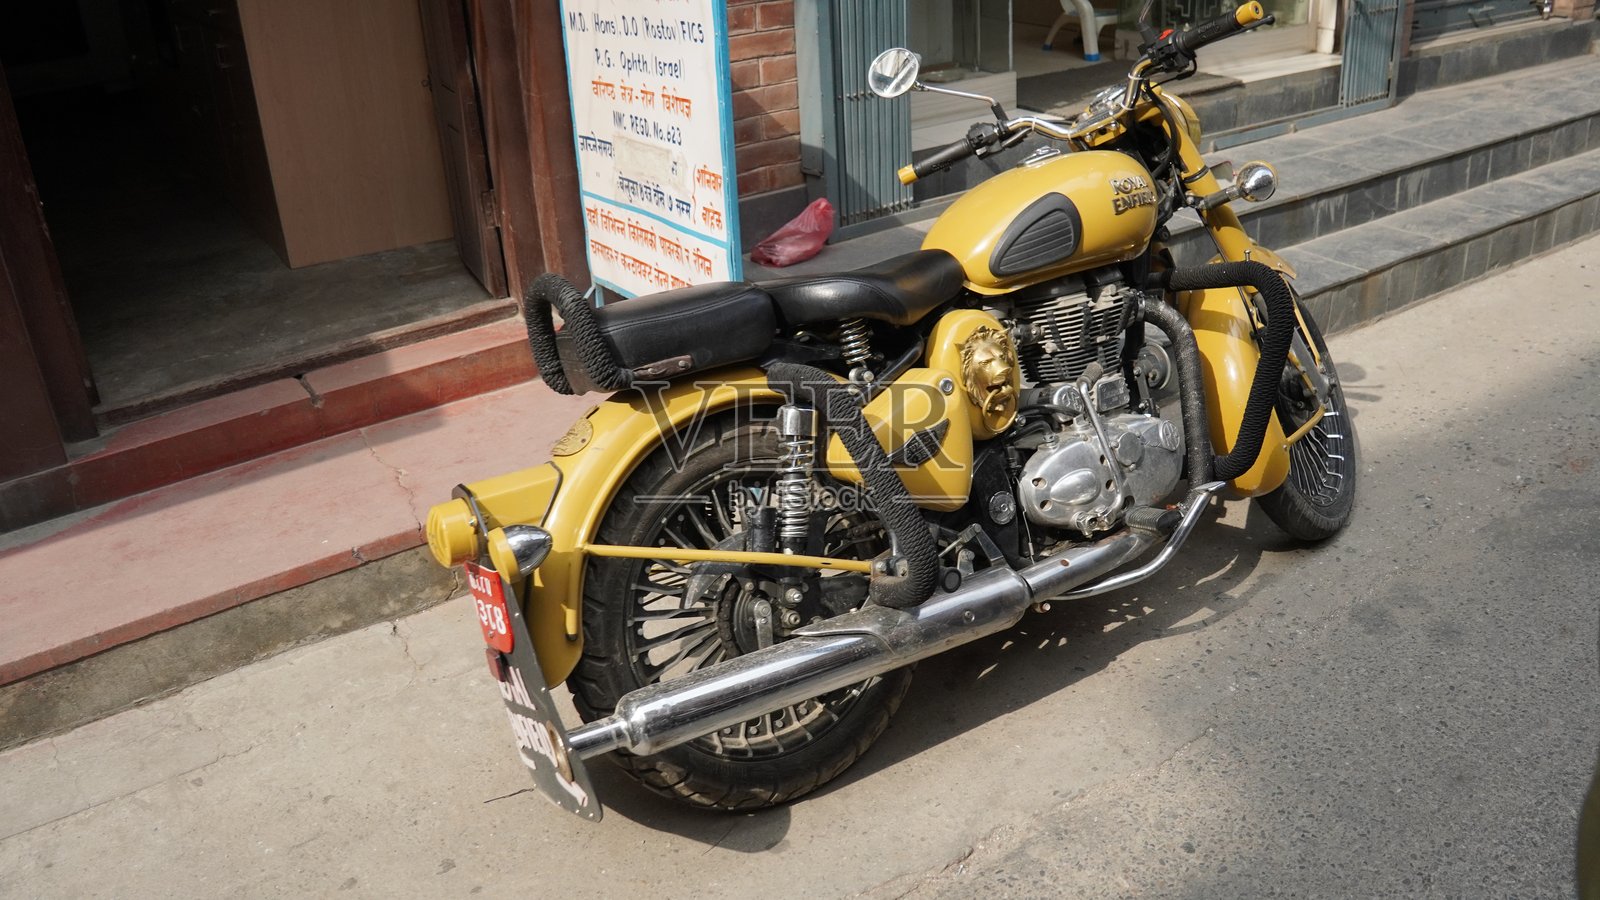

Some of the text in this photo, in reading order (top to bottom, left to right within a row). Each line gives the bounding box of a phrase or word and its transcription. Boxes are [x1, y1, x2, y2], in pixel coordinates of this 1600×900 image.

[569, 11, 588, 32] M.D.
[680, 21, 704, 43] FICS
[595, 48, 614, 68] P.G.
